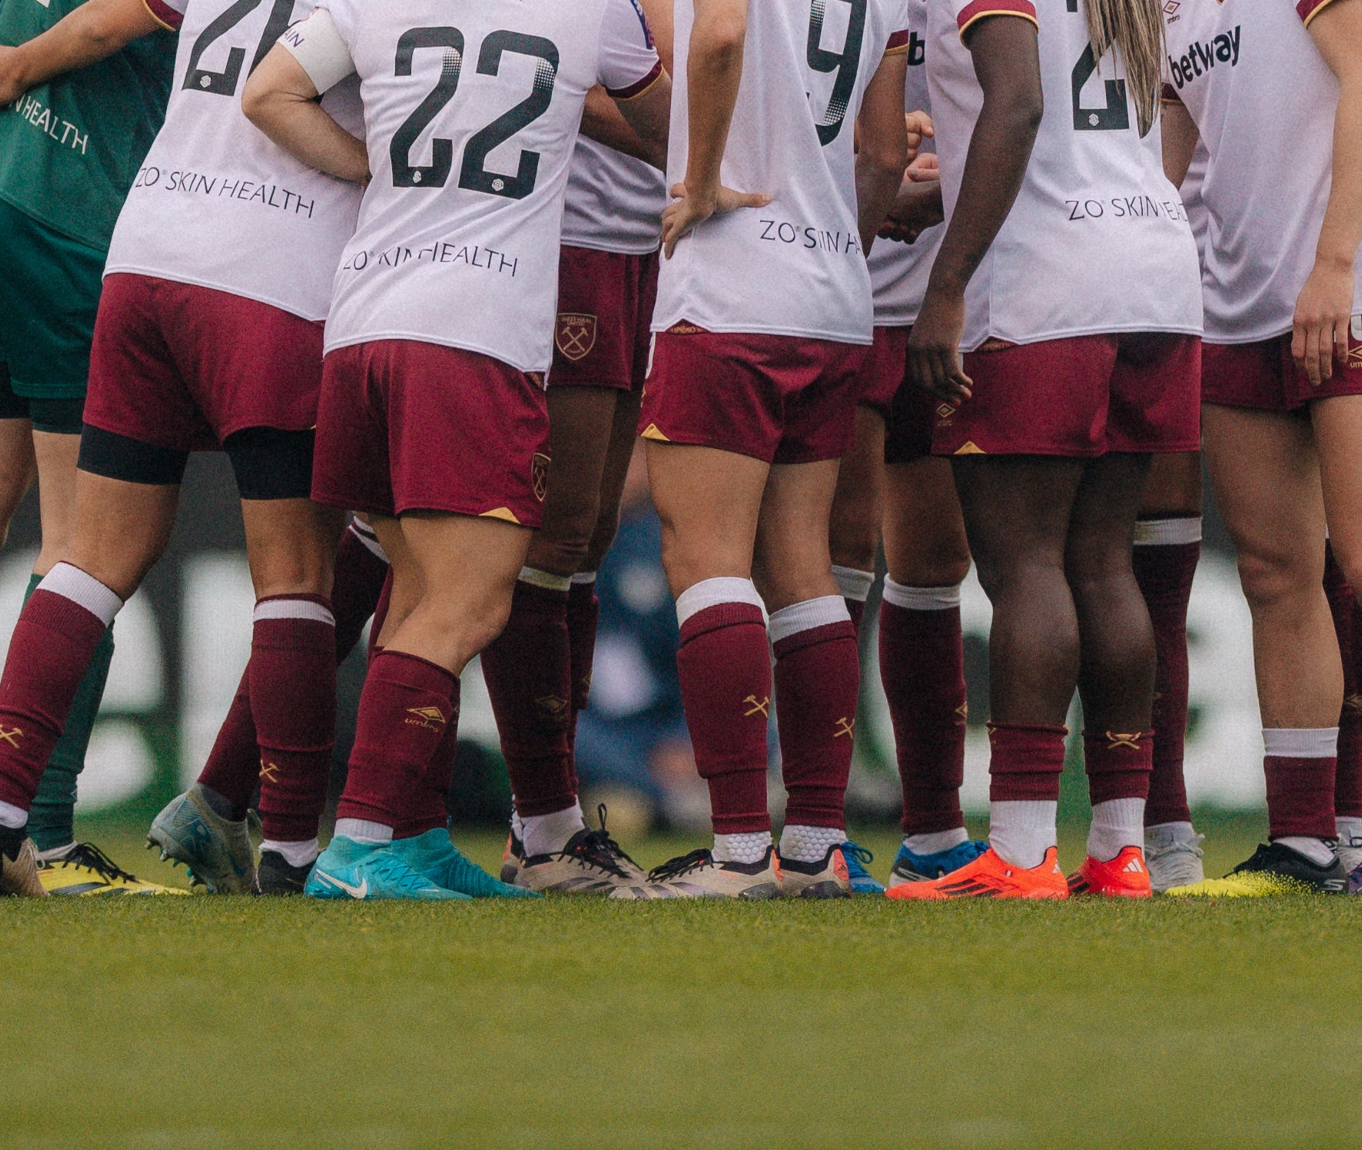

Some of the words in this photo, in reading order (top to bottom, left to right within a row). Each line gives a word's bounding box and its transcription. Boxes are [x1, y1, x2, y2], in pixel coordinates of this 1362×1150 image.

[1168, 25, 1241, 90] betway
[21, 95, 89, 155] HEALTH
[389, 26, 560, 200] 22
[165, 170, 217, 195] SKIN
[218, 178, 315, 219] HEALTH
[1111, 194, 1159, 218] SKIN
[417, 241, 518, 277] HEALTH
